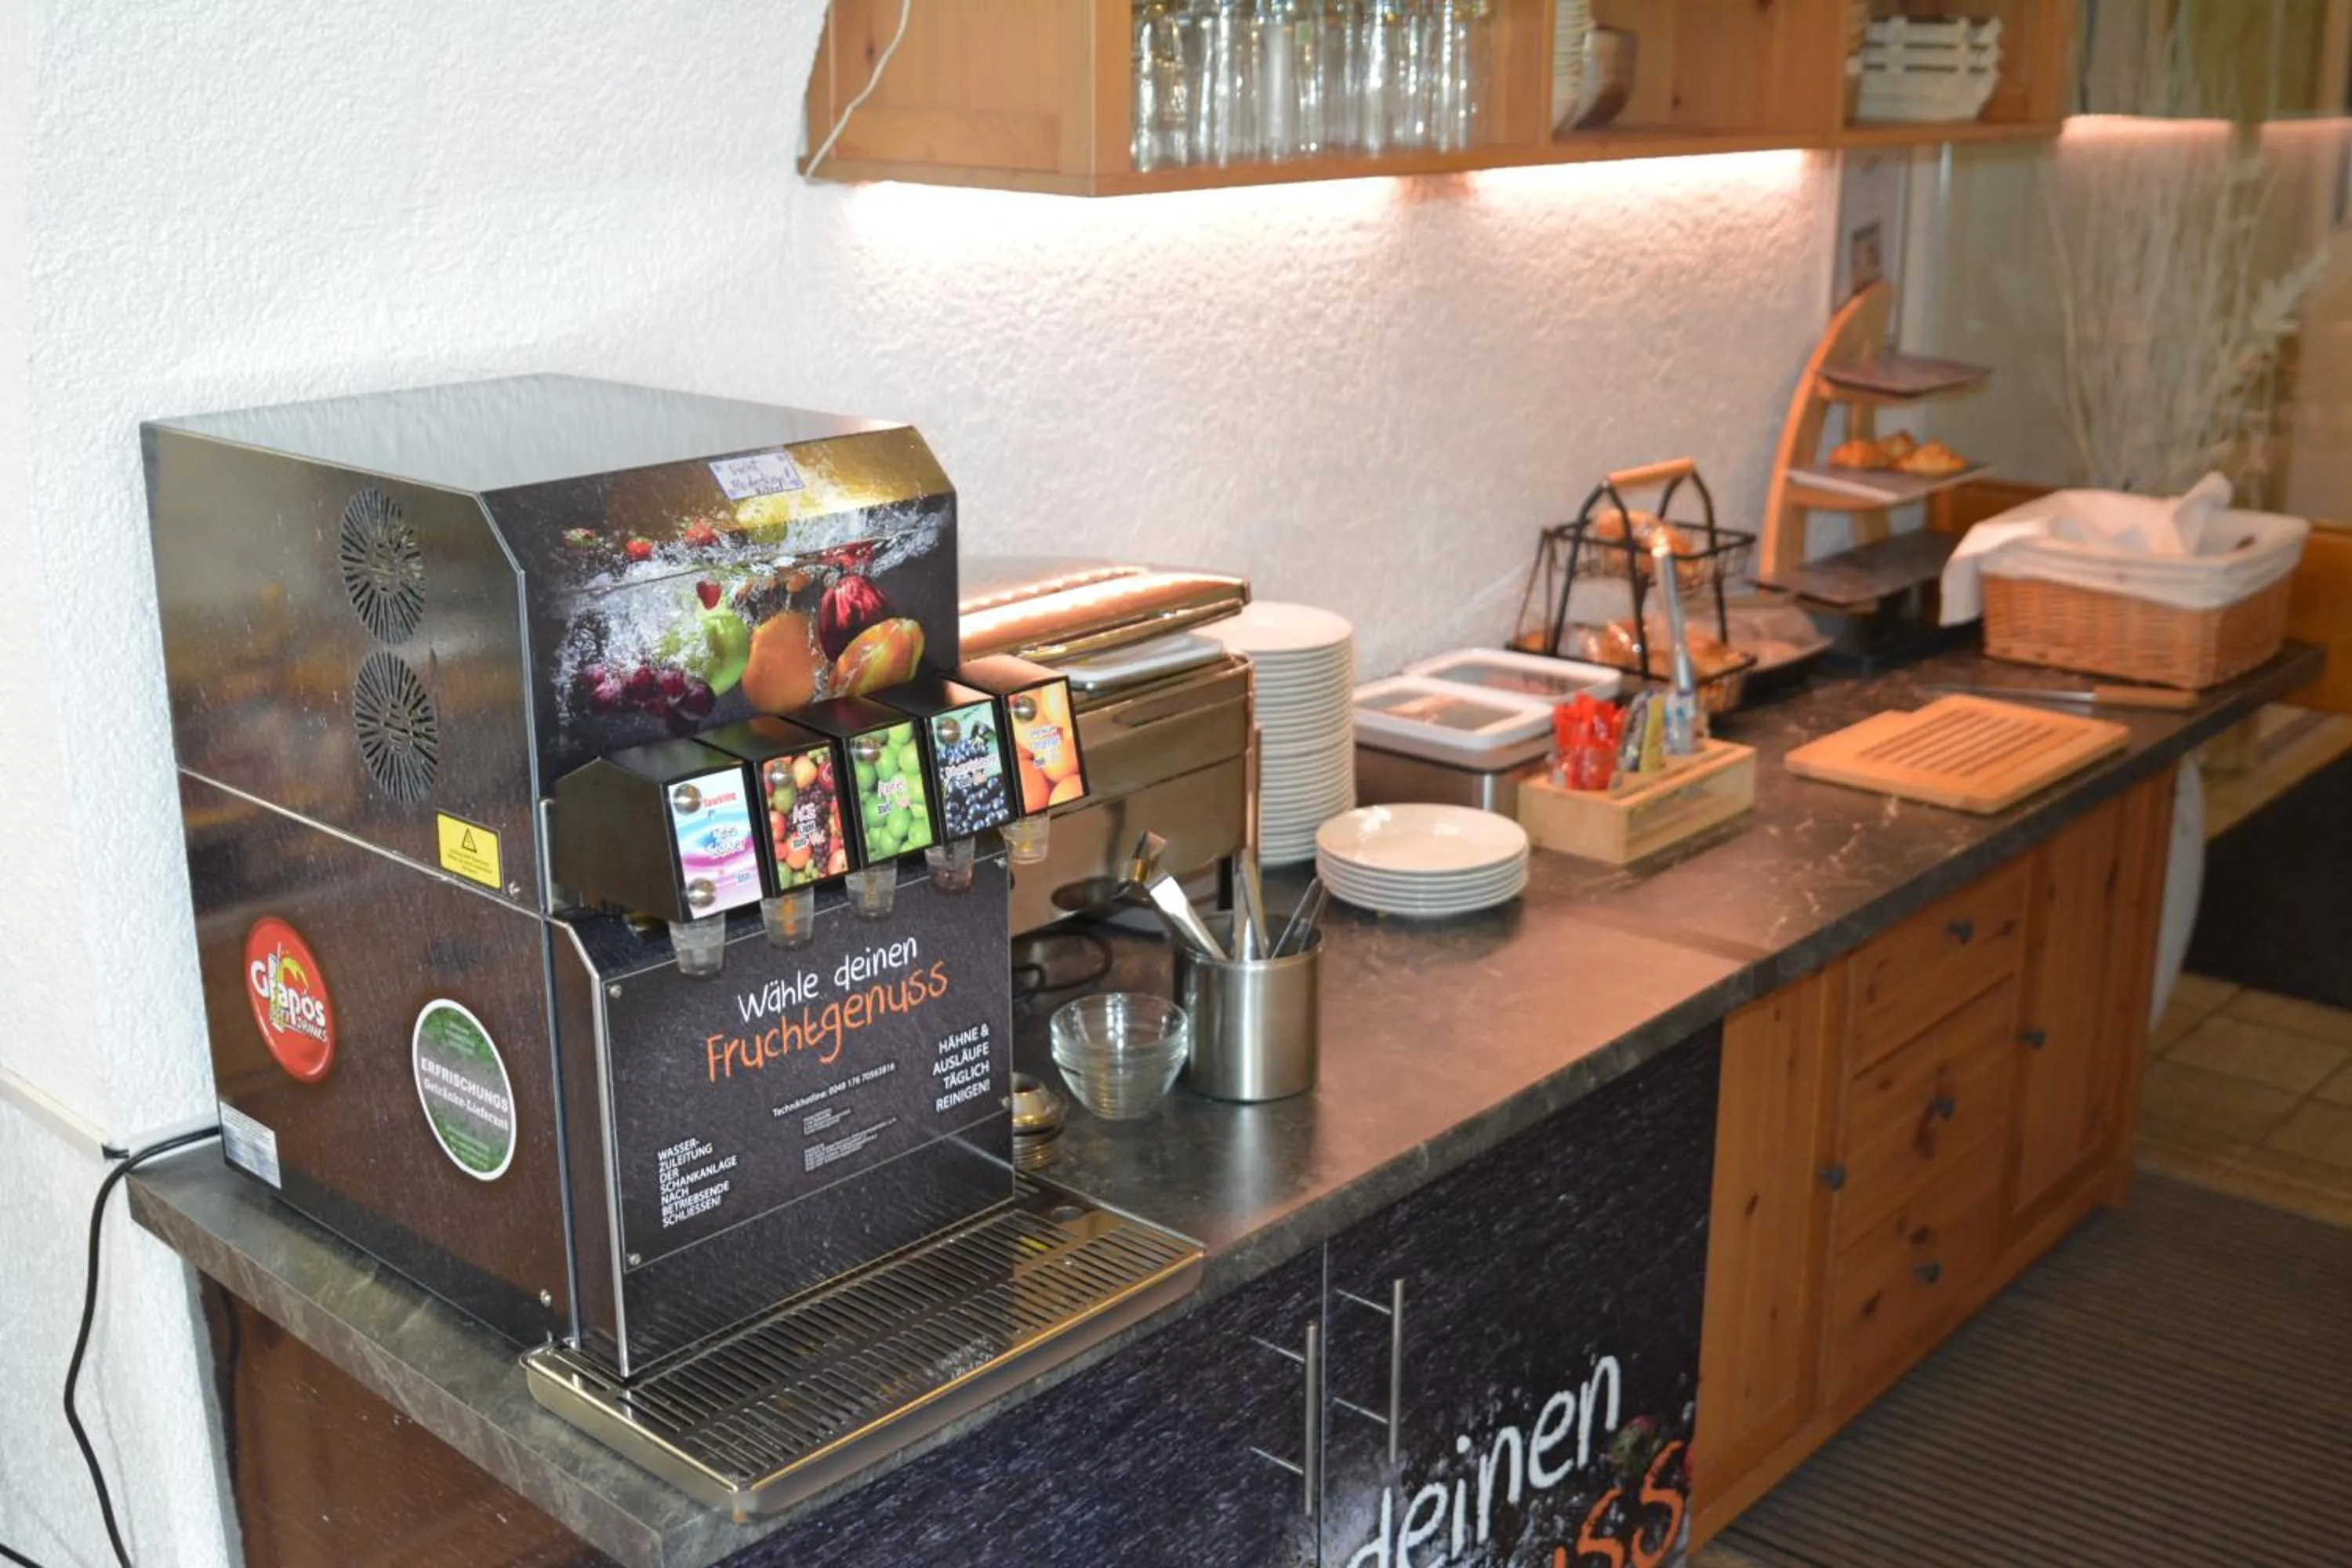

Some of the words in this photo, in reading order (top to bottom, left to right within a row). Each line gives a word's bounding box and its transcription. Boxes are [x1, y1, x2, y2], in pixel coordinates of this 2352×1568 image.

[250, 953, 325, 1027] Grapos
[737, 971, 818, 1023] Wähle
[834, 937, 917, 991] deinen
[707, 960, 949, 1083] Fruchtgenuss
[938, 1026, 978, 1054] HÄHNE
[981, 1023, 989, 1037] &
[932, 1041, 989, 1076] AUSLÄUFE
[943, 1060, 989, 1090] TÄGLICH
[420, 1056, 509, 1112] ERFRISCHUNGS
[936, 1079, 990, 1112] REINIGEN!
[658, 1138, 700, 1160] WASSER-
[659, 1142, 713, 1173] ZULEITUNG
[660, 1155, 738, 1195] SCHANKANLAGE
[660, 1167, 679, 1184] DER
[661, 1186, 689, 1206] NACH
[662, 1180, 730, 1216] BETRIEBSENDE
[1345, 1355, 1621, 1568] deinen
